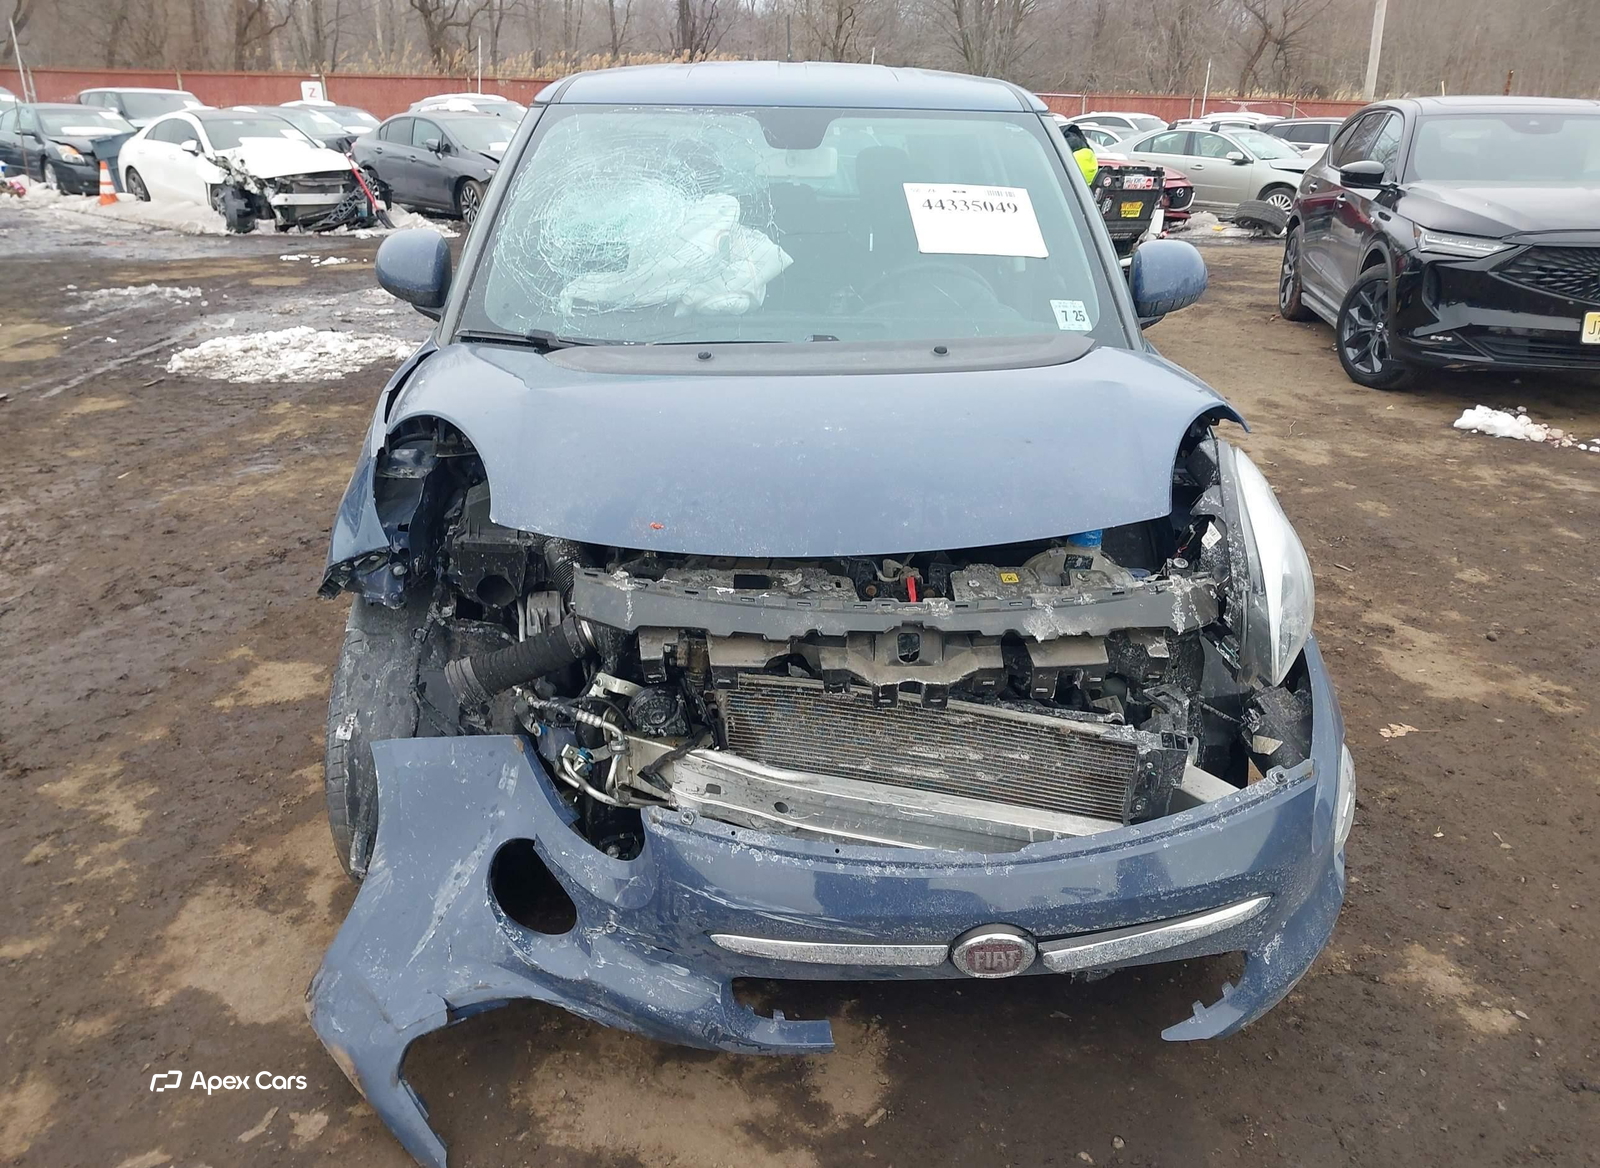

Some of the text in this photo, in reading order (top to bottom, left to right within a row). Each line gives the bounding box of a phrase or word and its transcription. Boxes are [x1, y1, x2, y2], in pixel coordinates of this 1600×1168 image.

[308, 87, 317, 98] Z
[922, 198, 1018, 214] 44335049
[1061, 309, 1086, 322] 7 25
[974, 949, 1020, 970] FIAT
